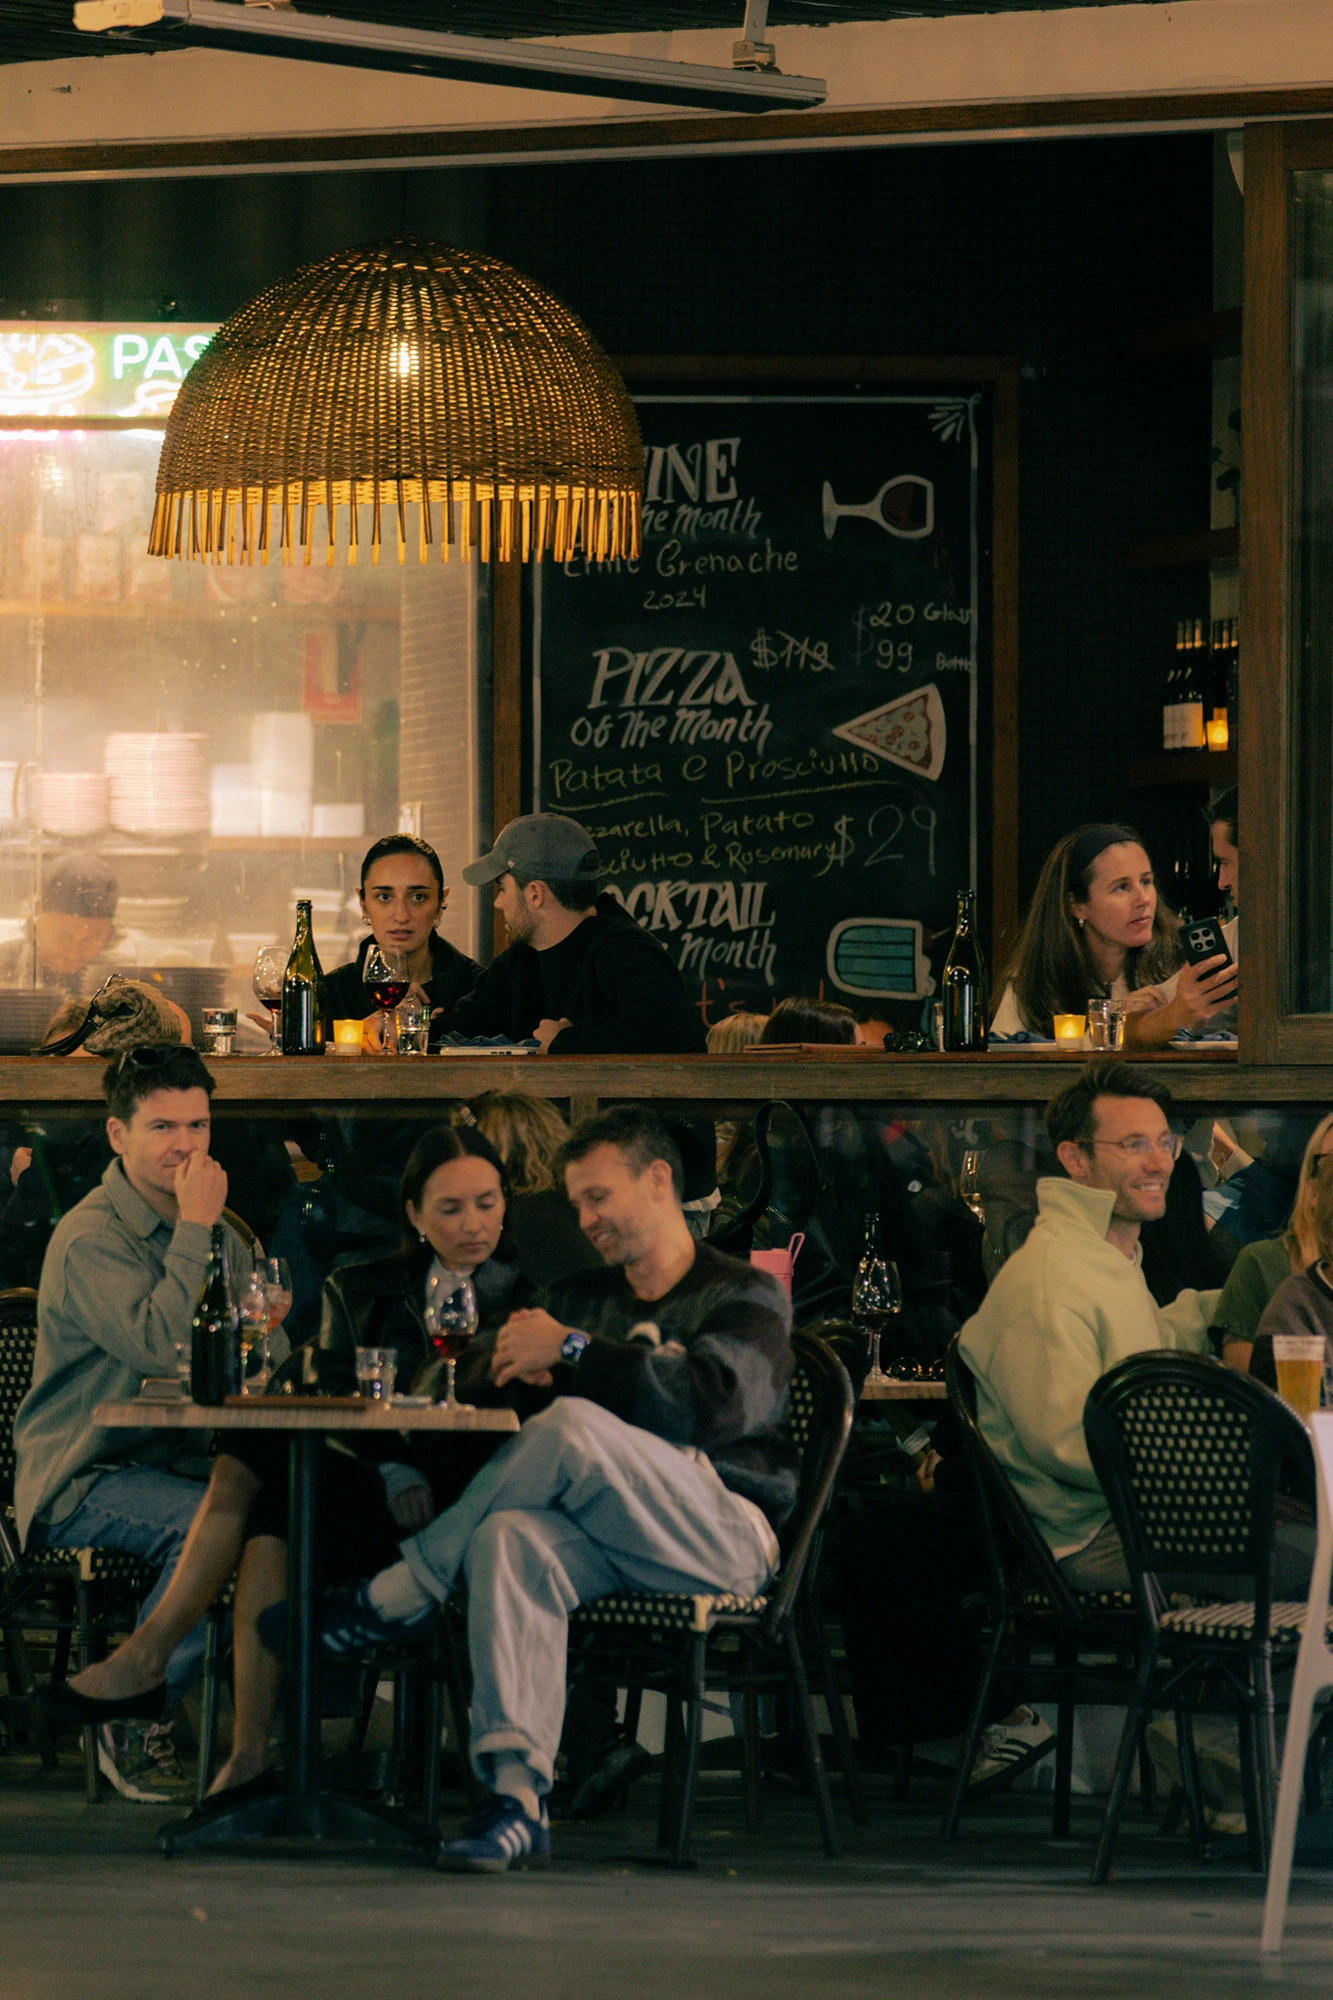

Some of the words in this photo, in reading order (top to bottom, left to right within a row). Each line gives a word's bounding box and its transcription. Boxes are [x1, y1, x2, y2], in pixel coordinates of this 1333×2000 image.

[113, 334, 209, 379] PAS
[643, 436, 742, 504] INE
[641, 503, 669, 535] he
[655, 538, 800, 578] Grenache
[642, 584, 708, 609] 2024
[587, 646, 758, 710] PIZZA
[617, 709, 669, 750] The
[549, 757, 664, 800] Patata
[583, 813, 690, 839] zzarella,
